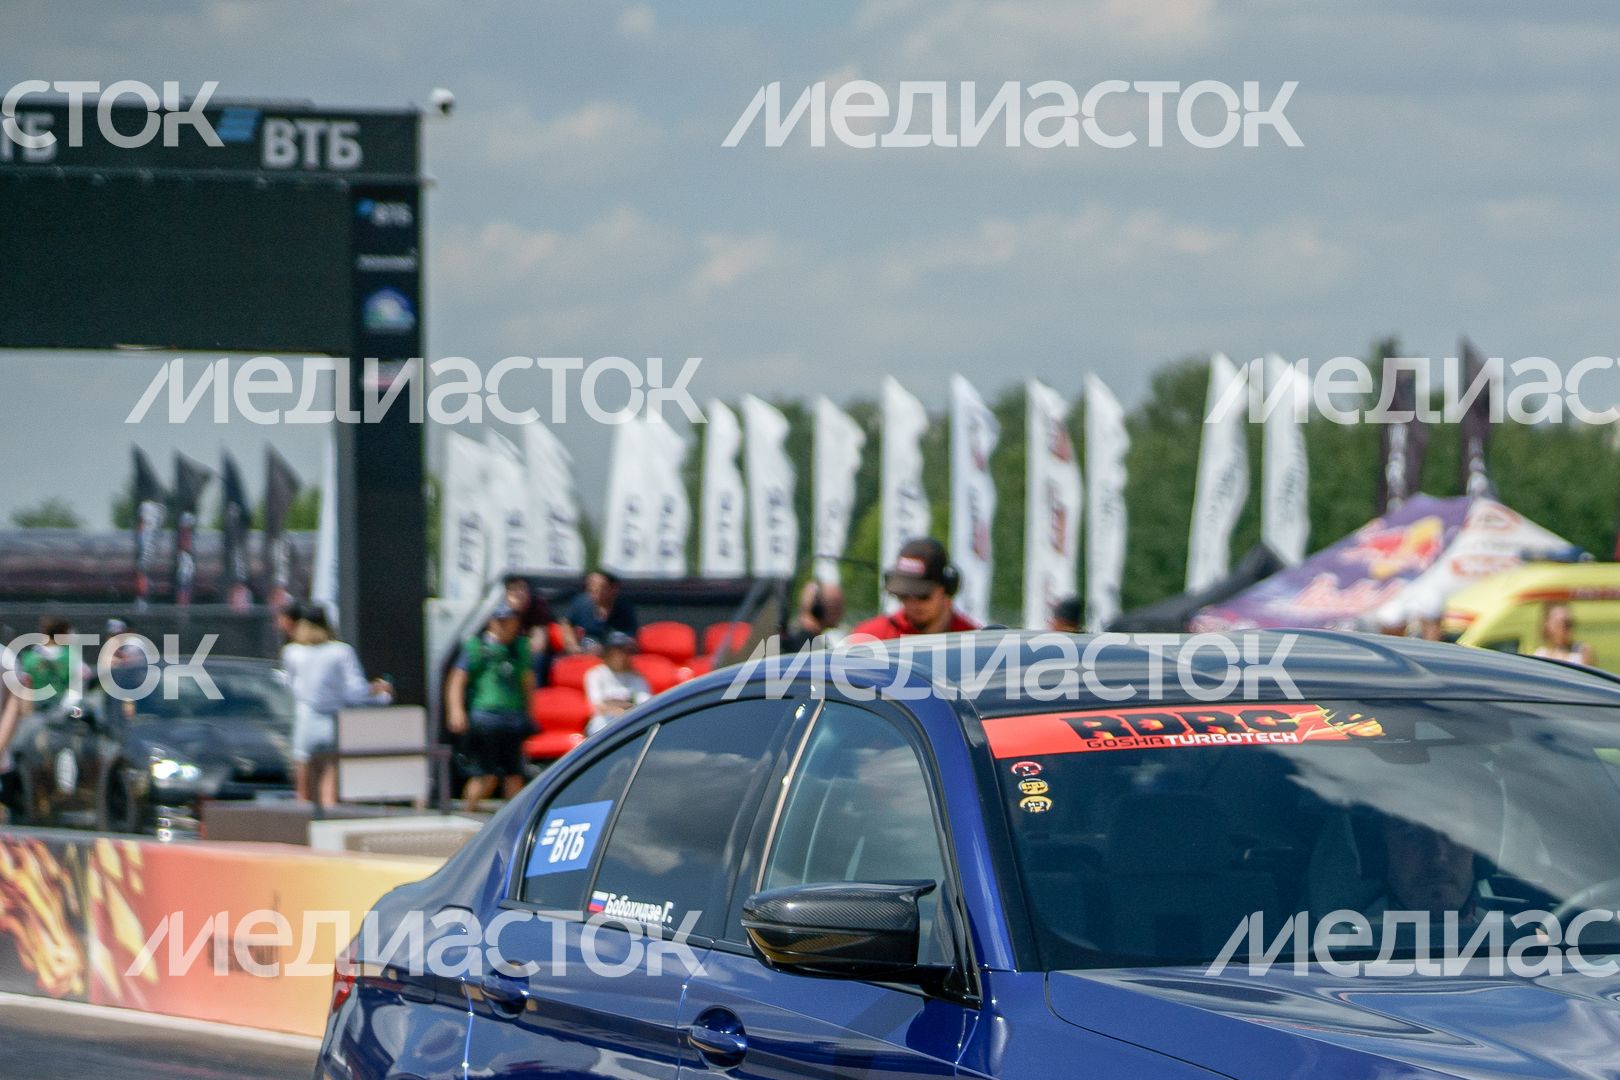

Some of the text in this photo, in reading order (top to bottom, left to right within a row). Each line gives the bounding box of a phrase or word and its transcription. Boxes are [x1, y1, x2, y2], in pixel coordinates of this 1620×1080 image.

[262, 116, 363, 171] ВТБ
[1060, 709, 1298, 740] RDRC
[549, 821, 591, 864] ВТБ
